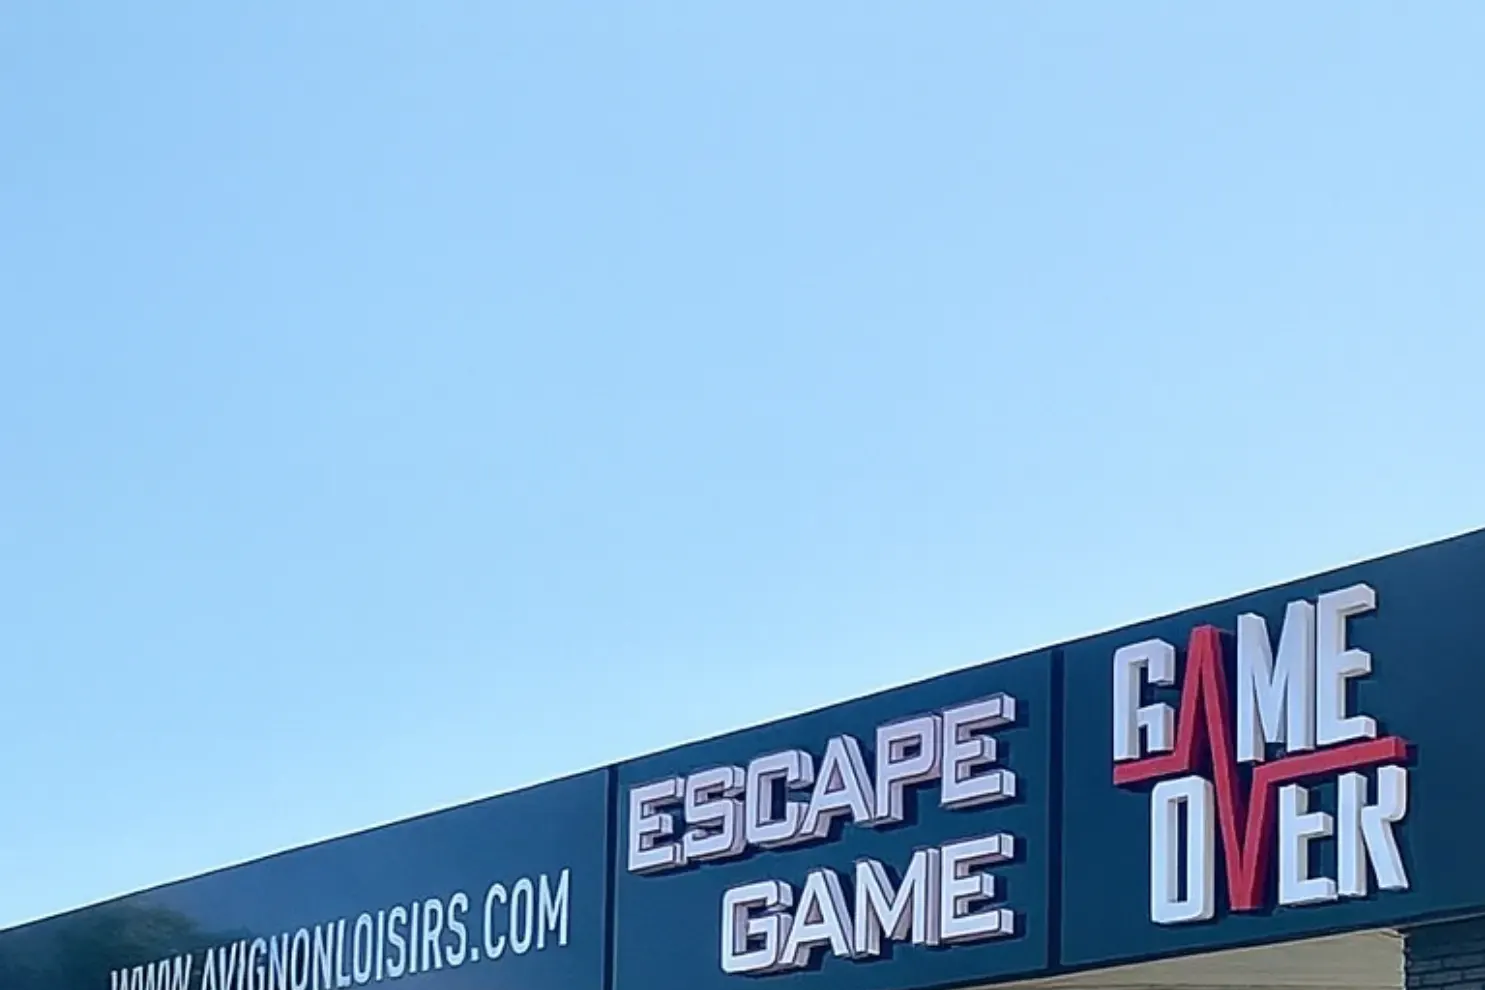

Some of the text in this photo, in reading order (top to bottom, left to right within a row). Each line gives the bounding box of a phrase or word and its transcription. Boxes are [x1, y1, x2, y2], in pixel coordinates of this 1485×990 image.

[1112, 583, 1378, 766] GAME
[628, 692, 1016, 874] ESCAPE
[1150, 763, 1409, 925] OVER
[718, 832, 1015, 974] GAME
